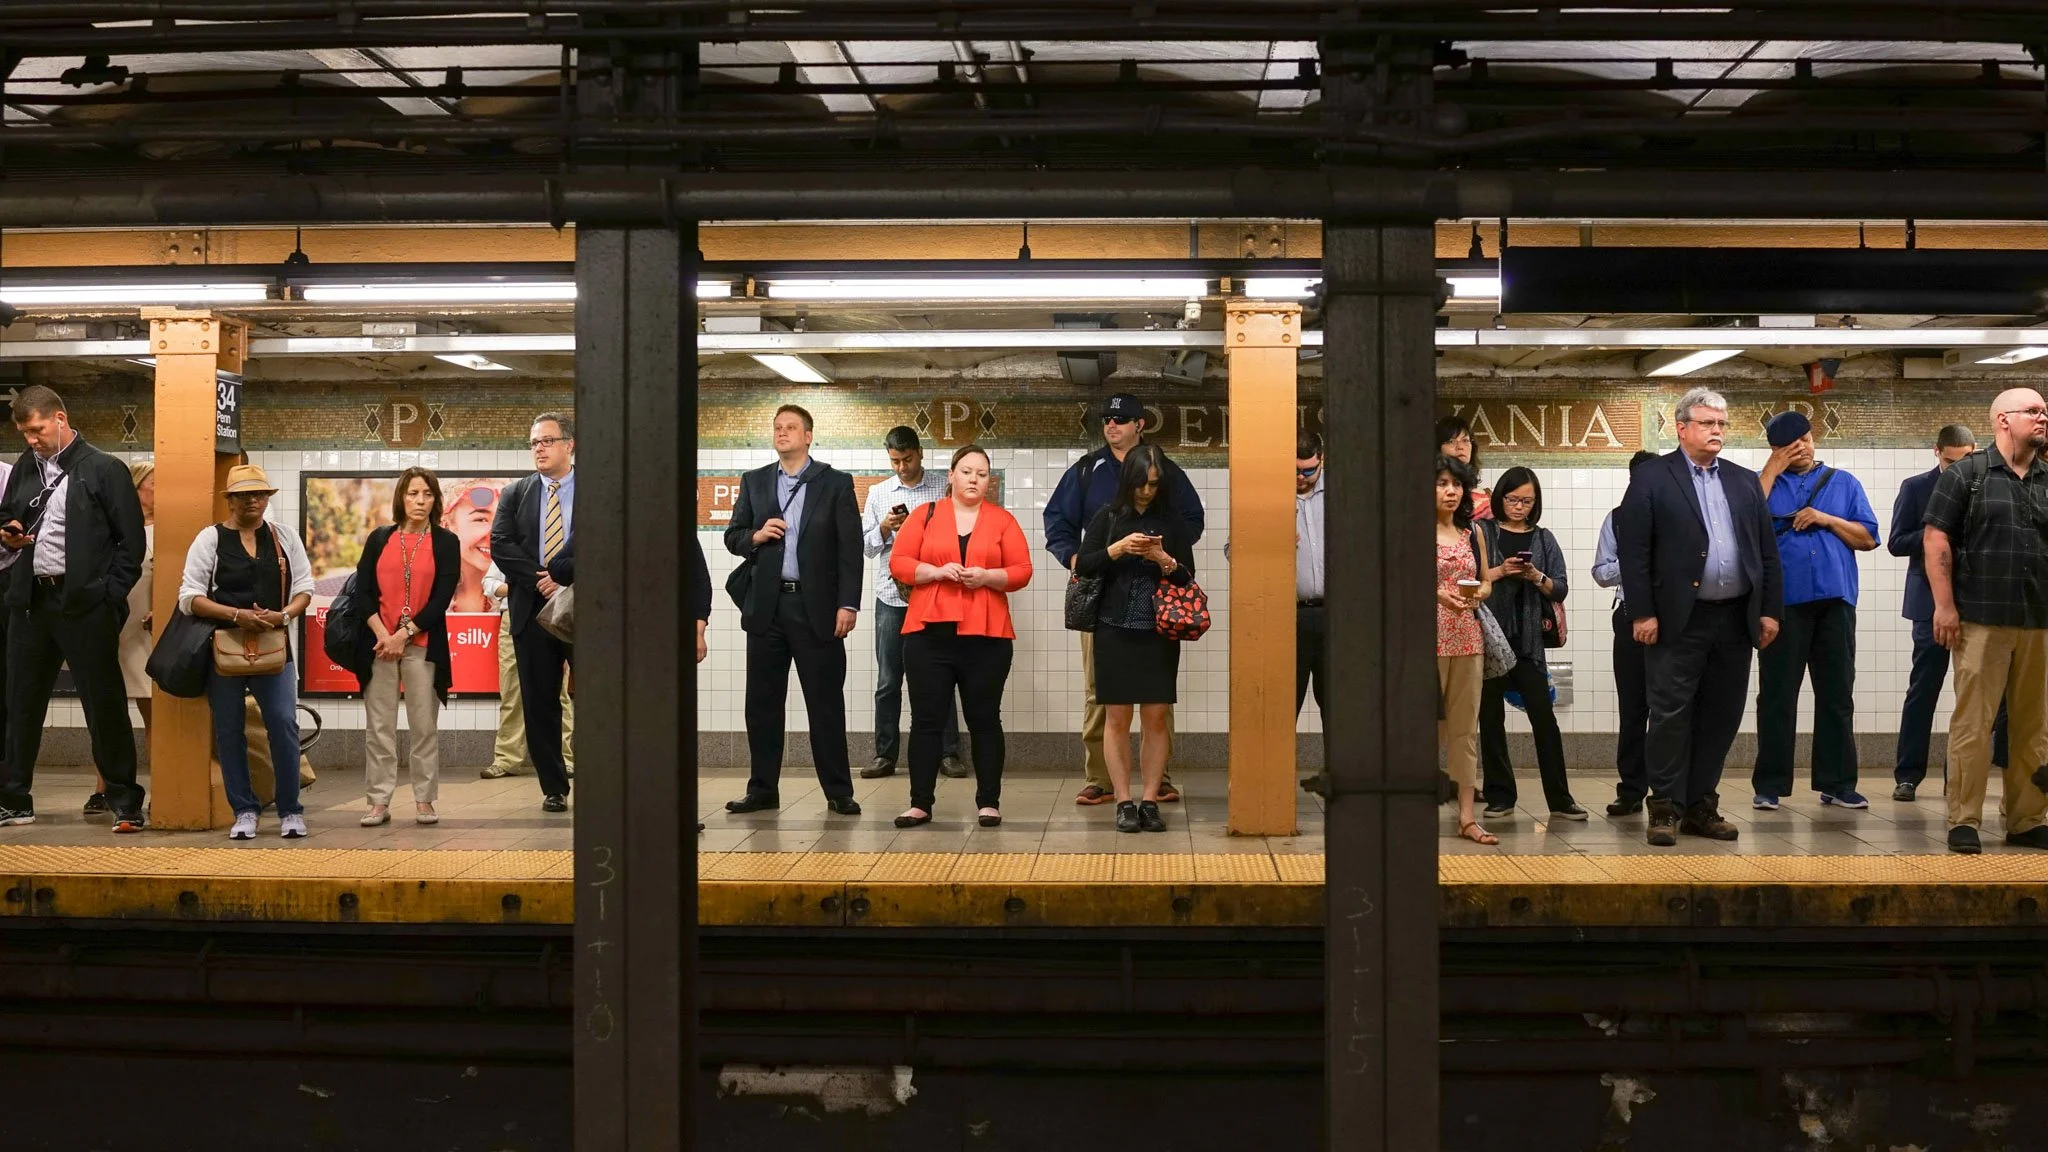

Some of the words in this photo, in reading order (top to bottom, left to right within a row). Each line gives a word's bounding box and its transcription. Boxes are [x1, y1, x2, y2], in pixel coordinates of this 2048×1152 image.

[217, 382, 236, 412] 34
[216, 410, 231, 424] Penn
[391, 403, 419, 442] P
[941, 401, 970, 440] P
[216, 423, 237, 439] Station
[456, 628, 493, 649] silly
